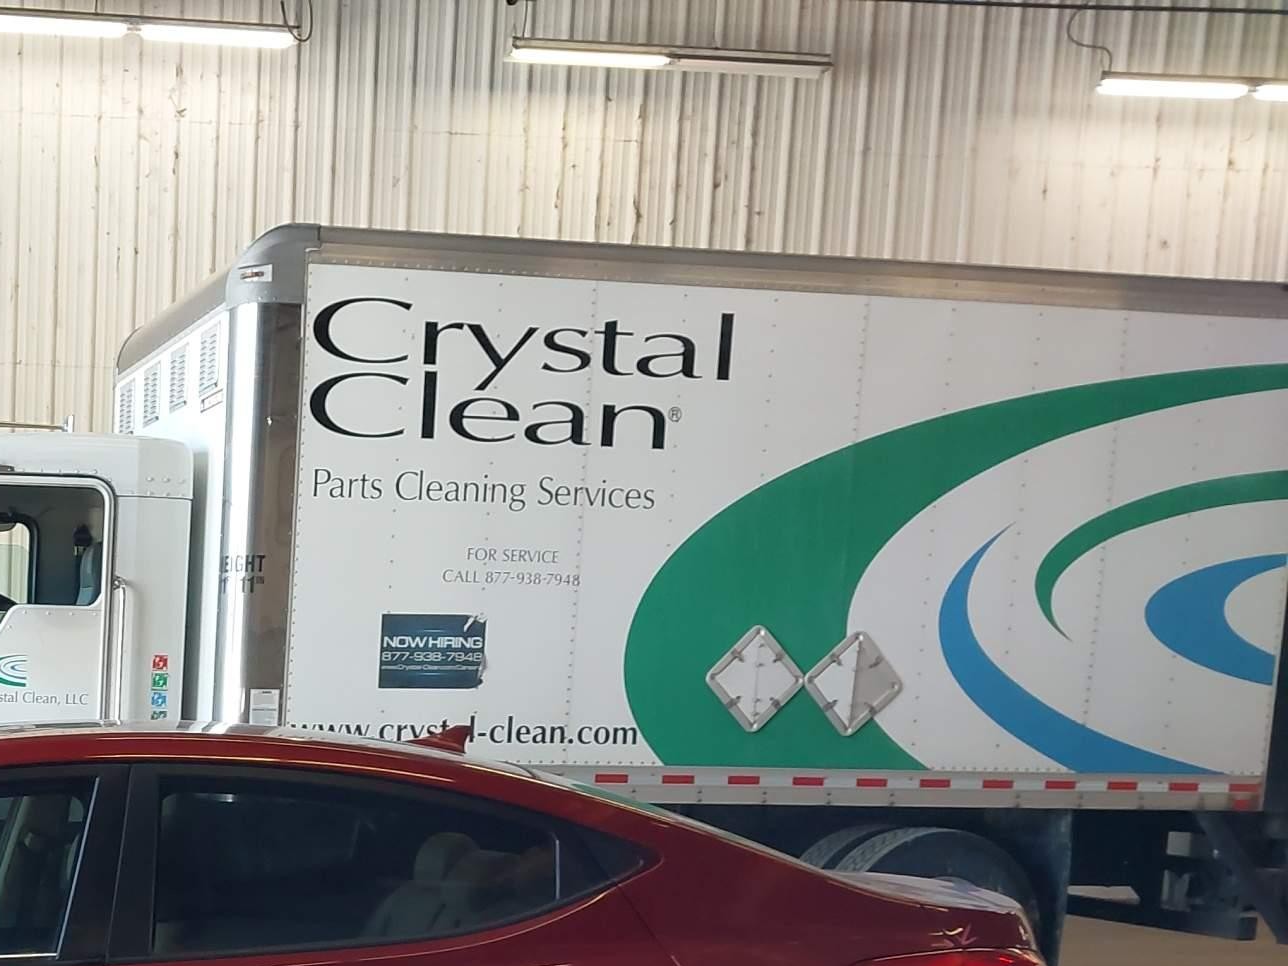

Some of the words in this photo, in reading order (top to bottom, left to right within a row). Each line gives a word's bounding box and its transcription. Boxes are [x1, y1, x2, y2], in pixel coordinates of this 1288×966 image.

[312, 297, 736, 391] Crystal
[312, 468, 384, 500] Parts
[395, 469, 526, 511] Cleaning
[538, 476, 656, 510] Services
[466, 547, 497, 561] FOR
[502, 548, 559, 564] SERVICE
[442, 569, 480, 584] CALL
[485, 571, 581, 587] 877-938-7948
[383, 636, 427, 648] NOW
[428, 636, 483, 649] HIRING
[381, 651, 483, 662] 877-938-7948
[22, 691, 61, 705] Clean,
[65, 693, 89, 705] LLC
